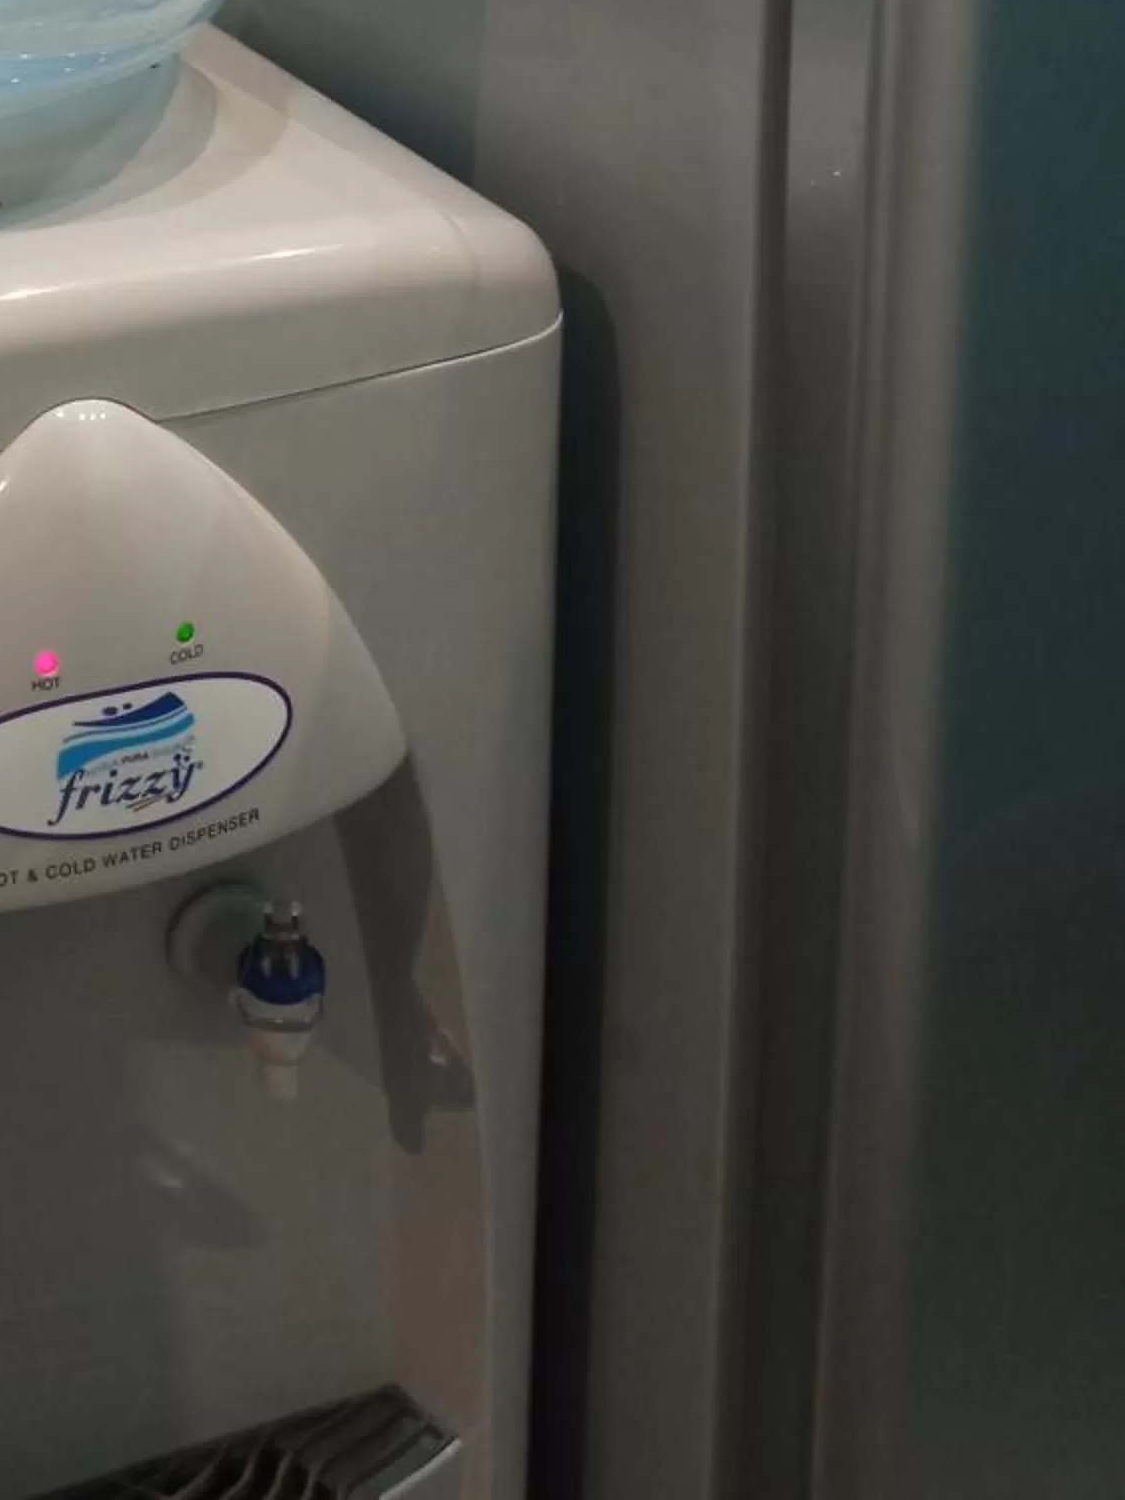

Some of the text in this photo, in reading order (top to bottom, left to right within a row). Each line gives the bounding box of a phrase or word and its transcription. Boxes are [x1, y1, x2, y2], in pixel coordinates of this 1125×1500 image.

[169, 643, 204, 665] COLD
[31, 676, 61, 692] HOT
[26, 866, 38, 883] &
[45, 856, 97, 881] COLD
[102, 841, 164, 869] WATER
[169, 807, 261, 852] DISPENSER
